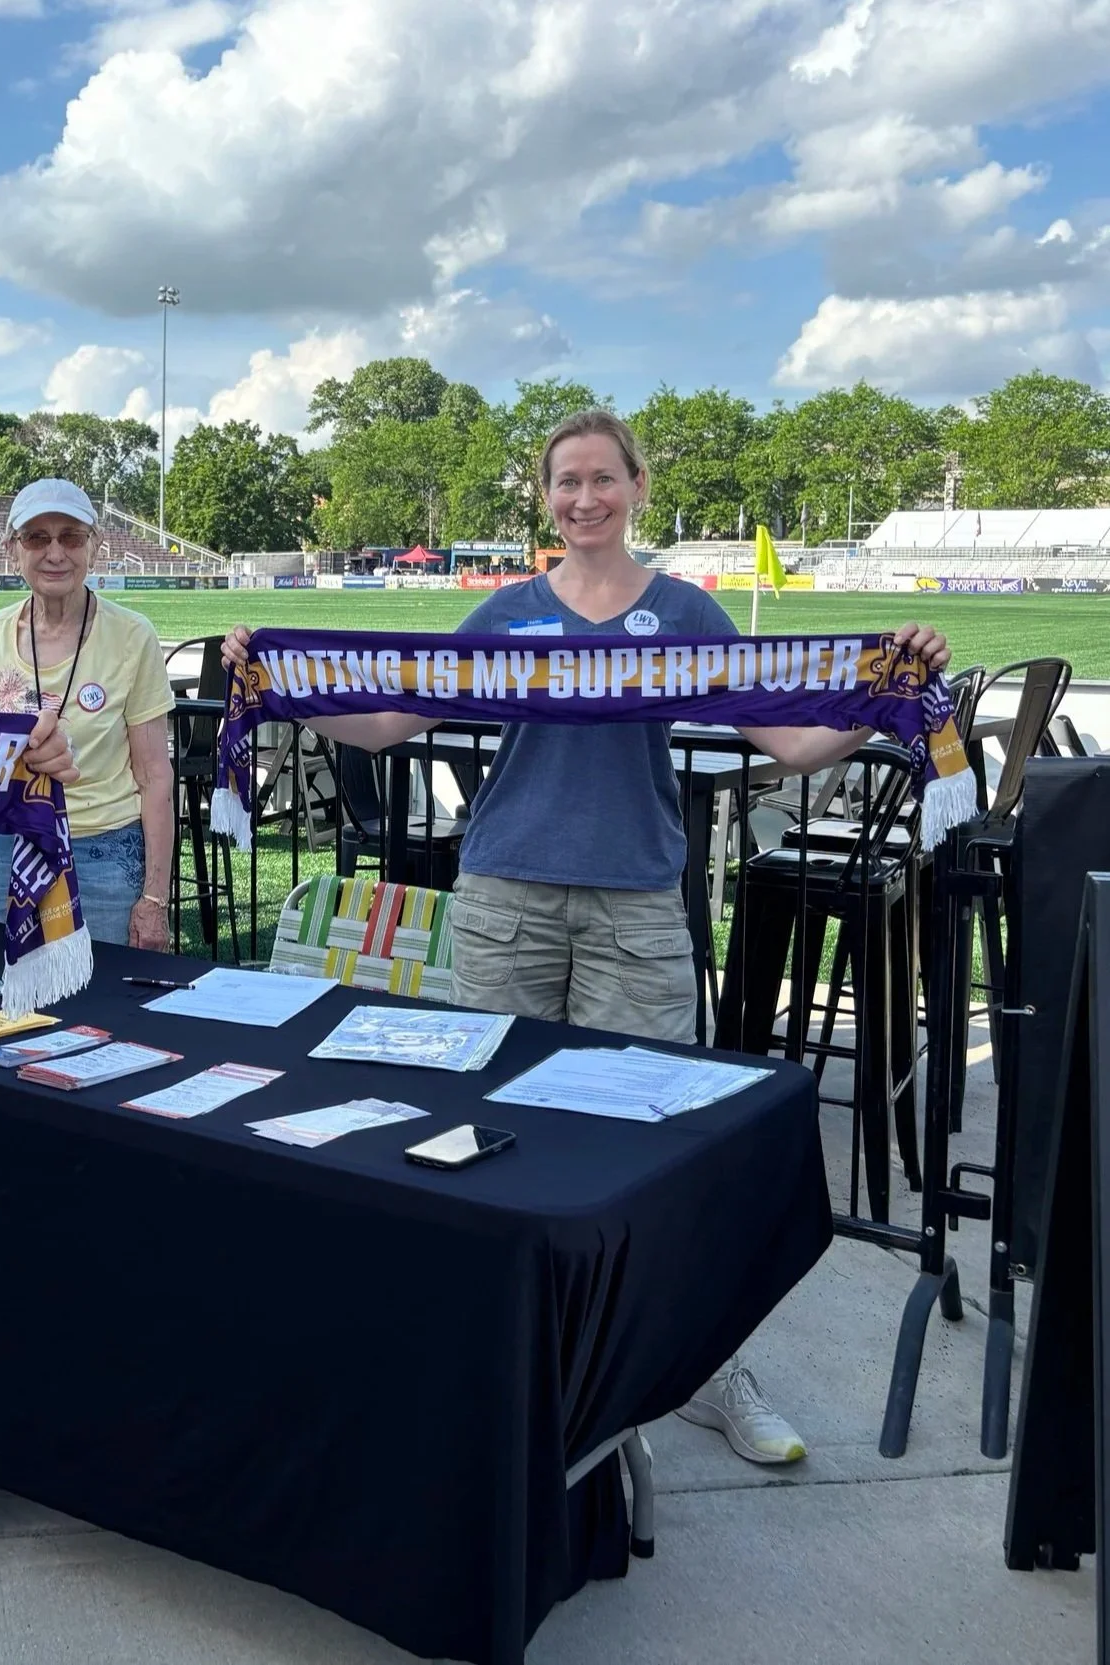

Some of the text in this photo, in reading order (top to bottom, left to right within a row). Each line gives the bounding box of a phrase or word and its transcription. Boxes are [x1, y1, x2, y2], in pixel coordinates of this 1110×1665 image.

[947, 582, 976, 592] SPORT
[257, 638, 863, 700] VOTING IS MY SUPERPOWER
